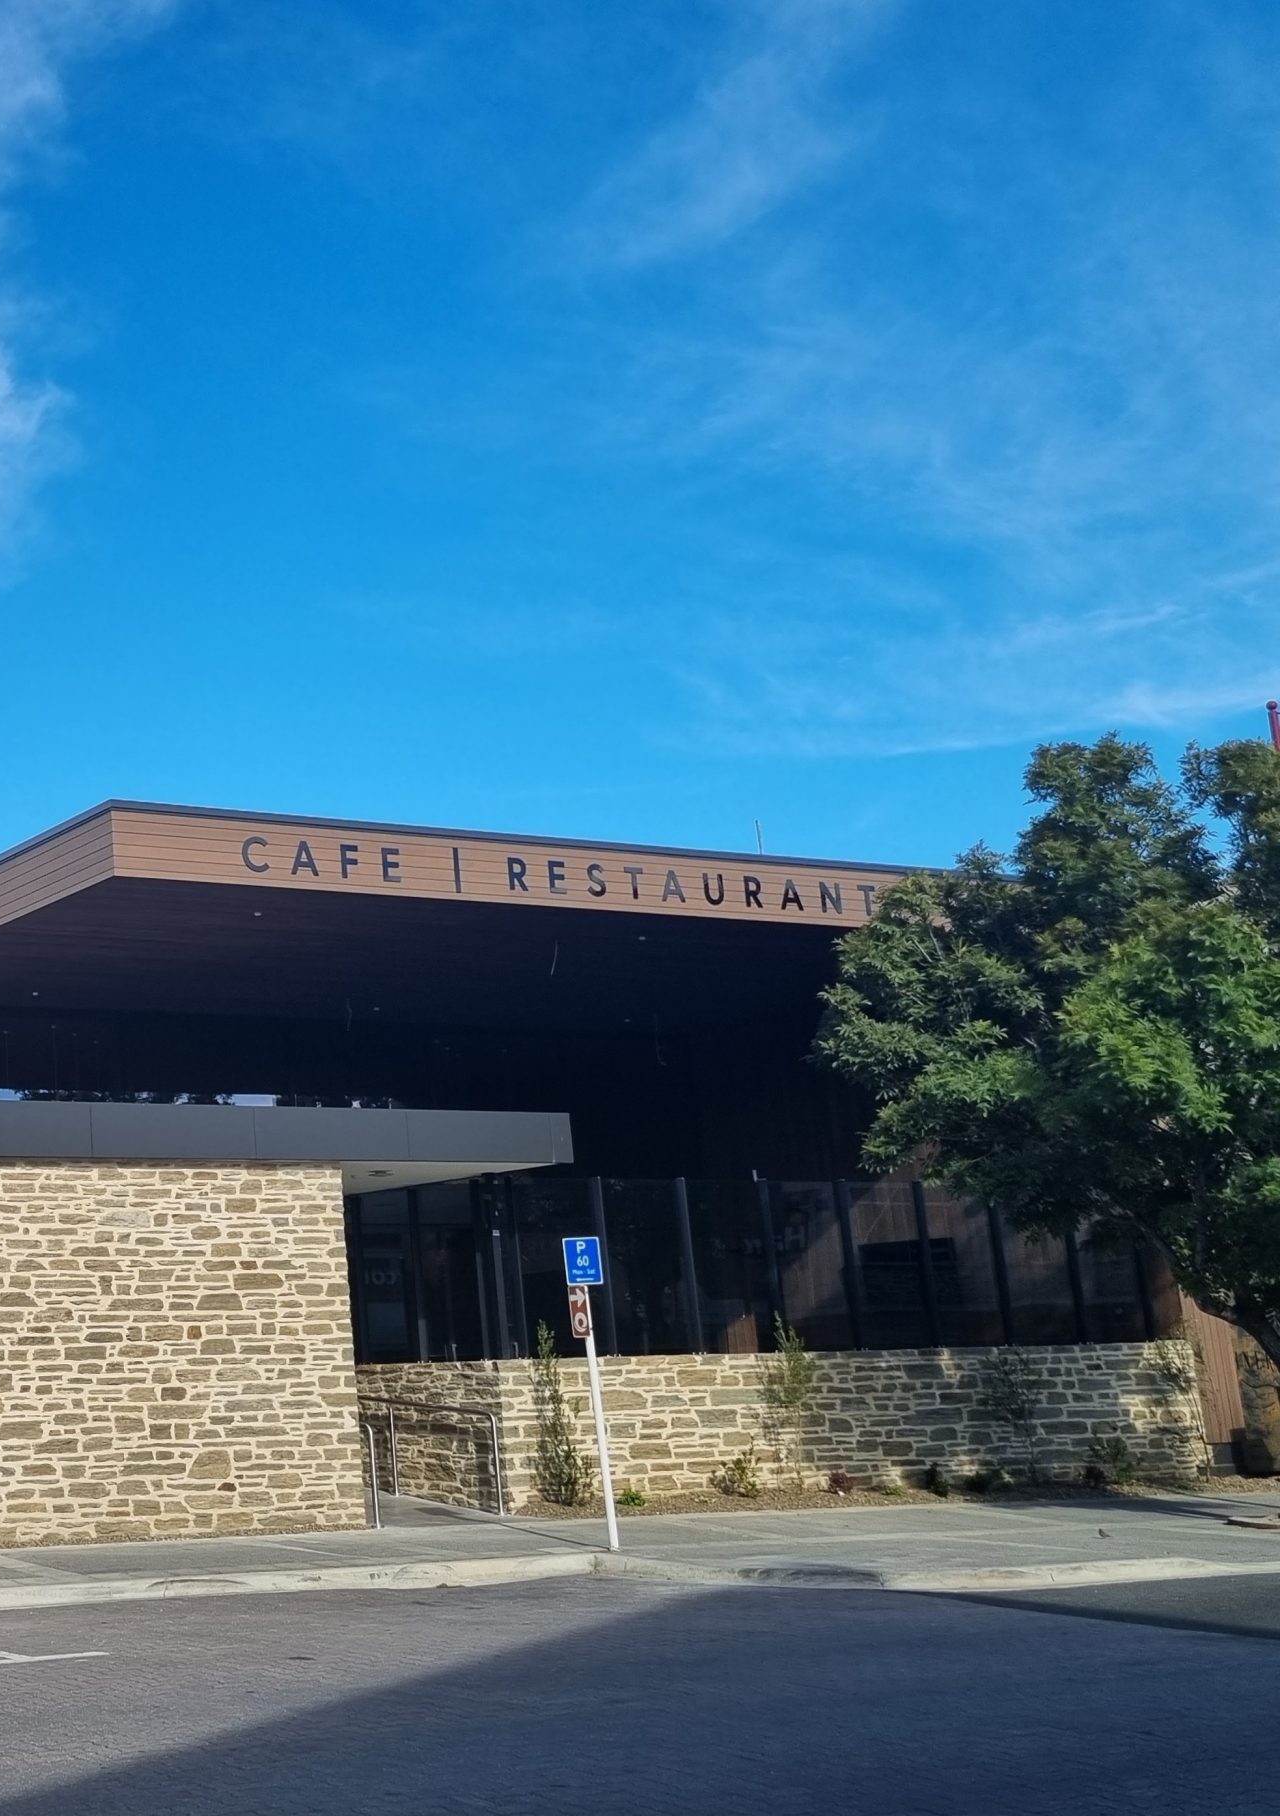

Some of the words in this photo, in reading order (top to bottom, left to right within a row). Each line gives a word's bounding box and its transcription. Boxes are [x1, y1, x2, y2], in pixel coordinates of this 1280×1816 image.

[241, 836, 402, 882] CAFE
[507, 857, 875, 917] RESTAURANT
[576, 1241, 586, 1254] P
[577, 1255, 589, 1267] 60
